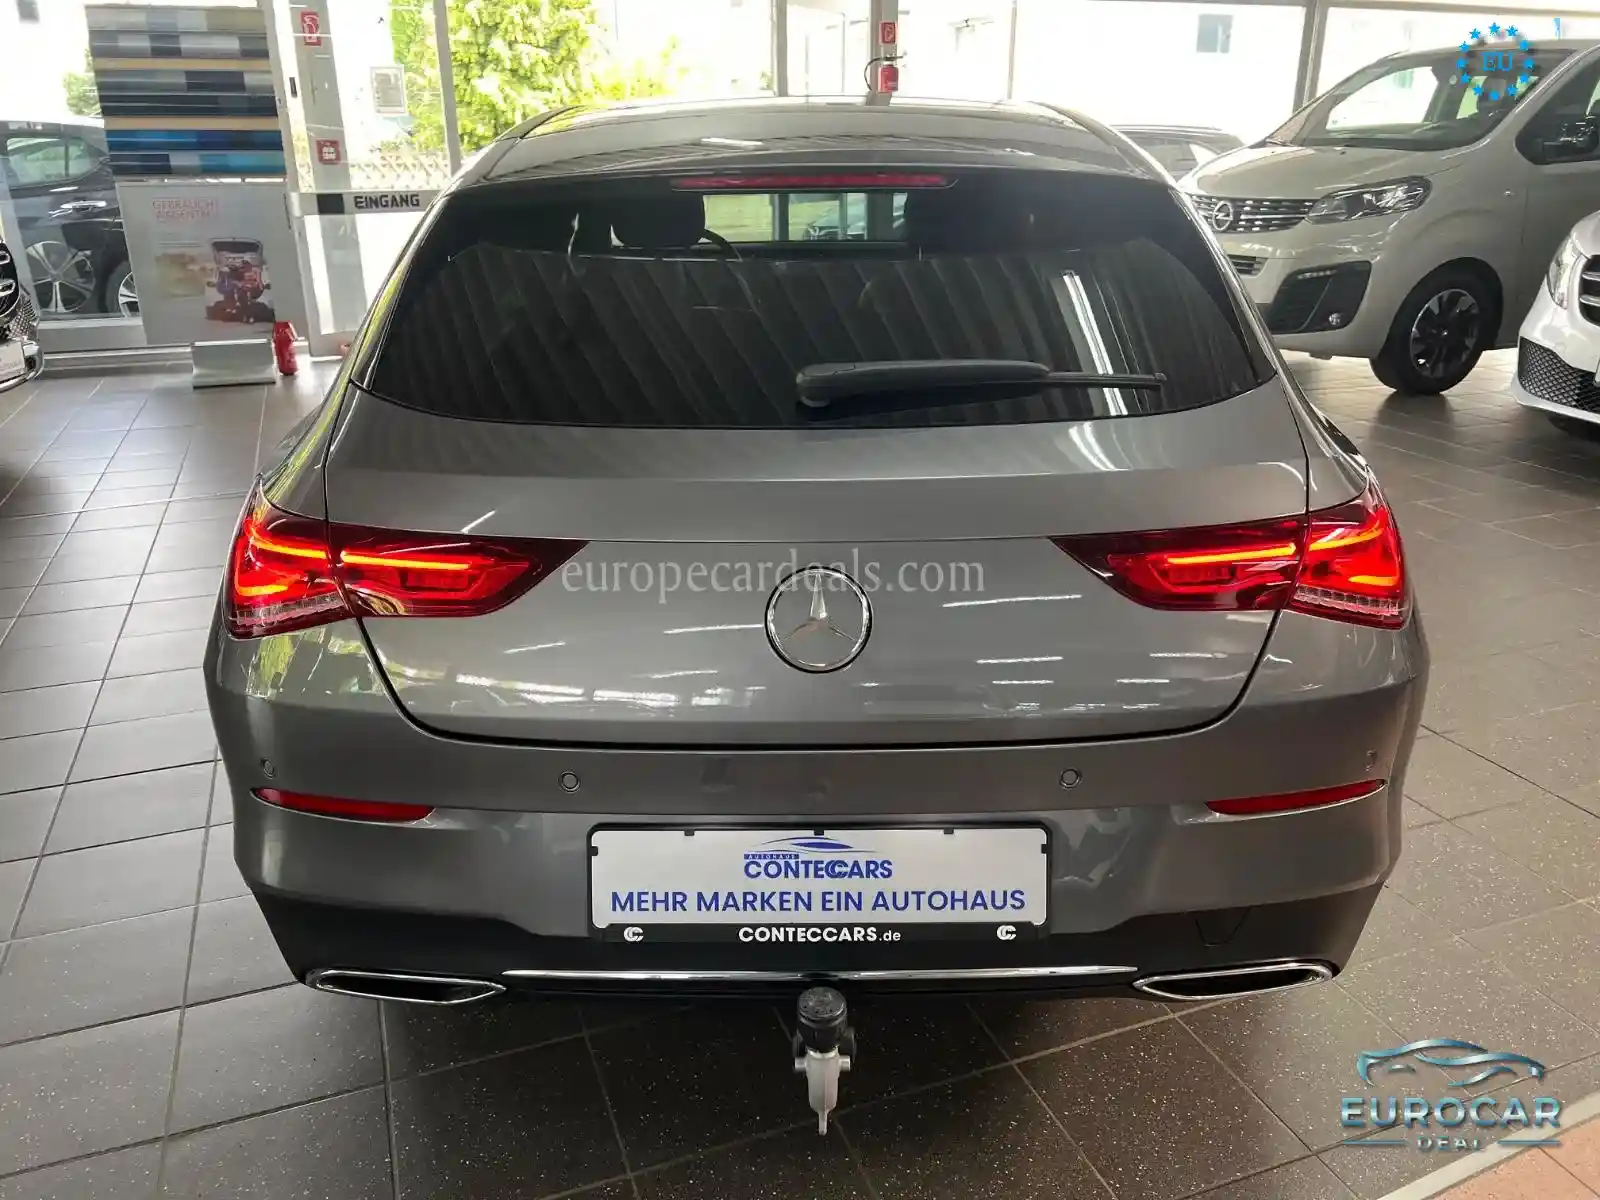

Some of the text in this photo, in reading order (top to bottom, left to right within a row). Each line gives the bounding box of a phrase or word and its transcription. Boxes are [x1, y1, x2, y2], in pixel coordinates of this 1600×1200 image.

[354, 194, 420, 210] EINGANG
[744, 860, 893, 879] CONTECCARS
[611, 890, 1026, 912] MEHR MARKEN EIN AUTOHAUS
[738, 926, 901, 942] CONTECCARS.de
